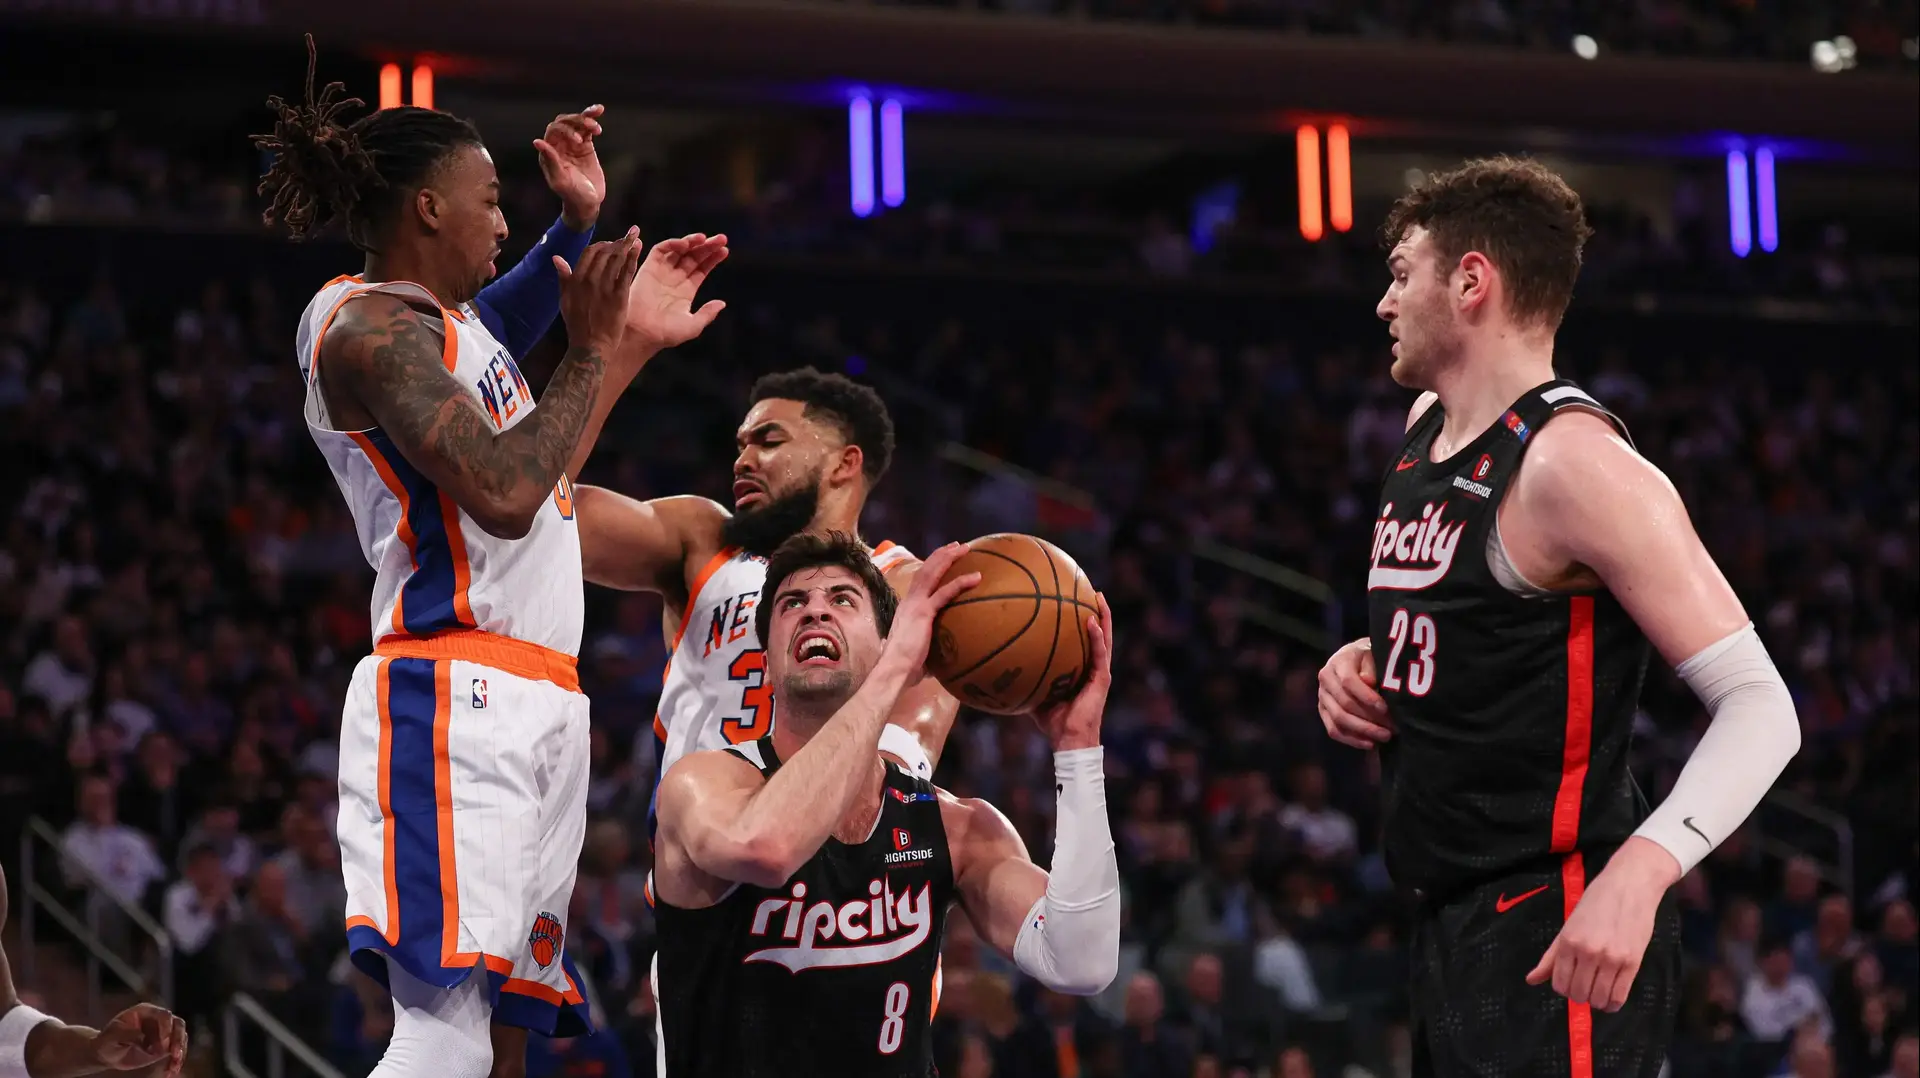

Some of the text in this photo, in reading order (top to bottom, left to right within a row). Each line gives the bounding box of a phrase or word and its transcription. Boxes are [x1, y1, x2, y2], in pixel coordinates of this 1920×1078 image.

[477, 349, 530, 430] NEW
[1452, 476, 1493, 499] BRIGHTSIDE
[1367, 500, 1467, 591] ipcity
[703, 591, 759, 658] NE
[1382, 607, 1437, 697] 23
[720, 649, 775, 745] 3
[903, 792, 917, 804] 32
[884, 848, 933, 863] RIGHTSIDE
[743, 872, 931, 974] ripcity
[878, 982, 911, 1055] 8
